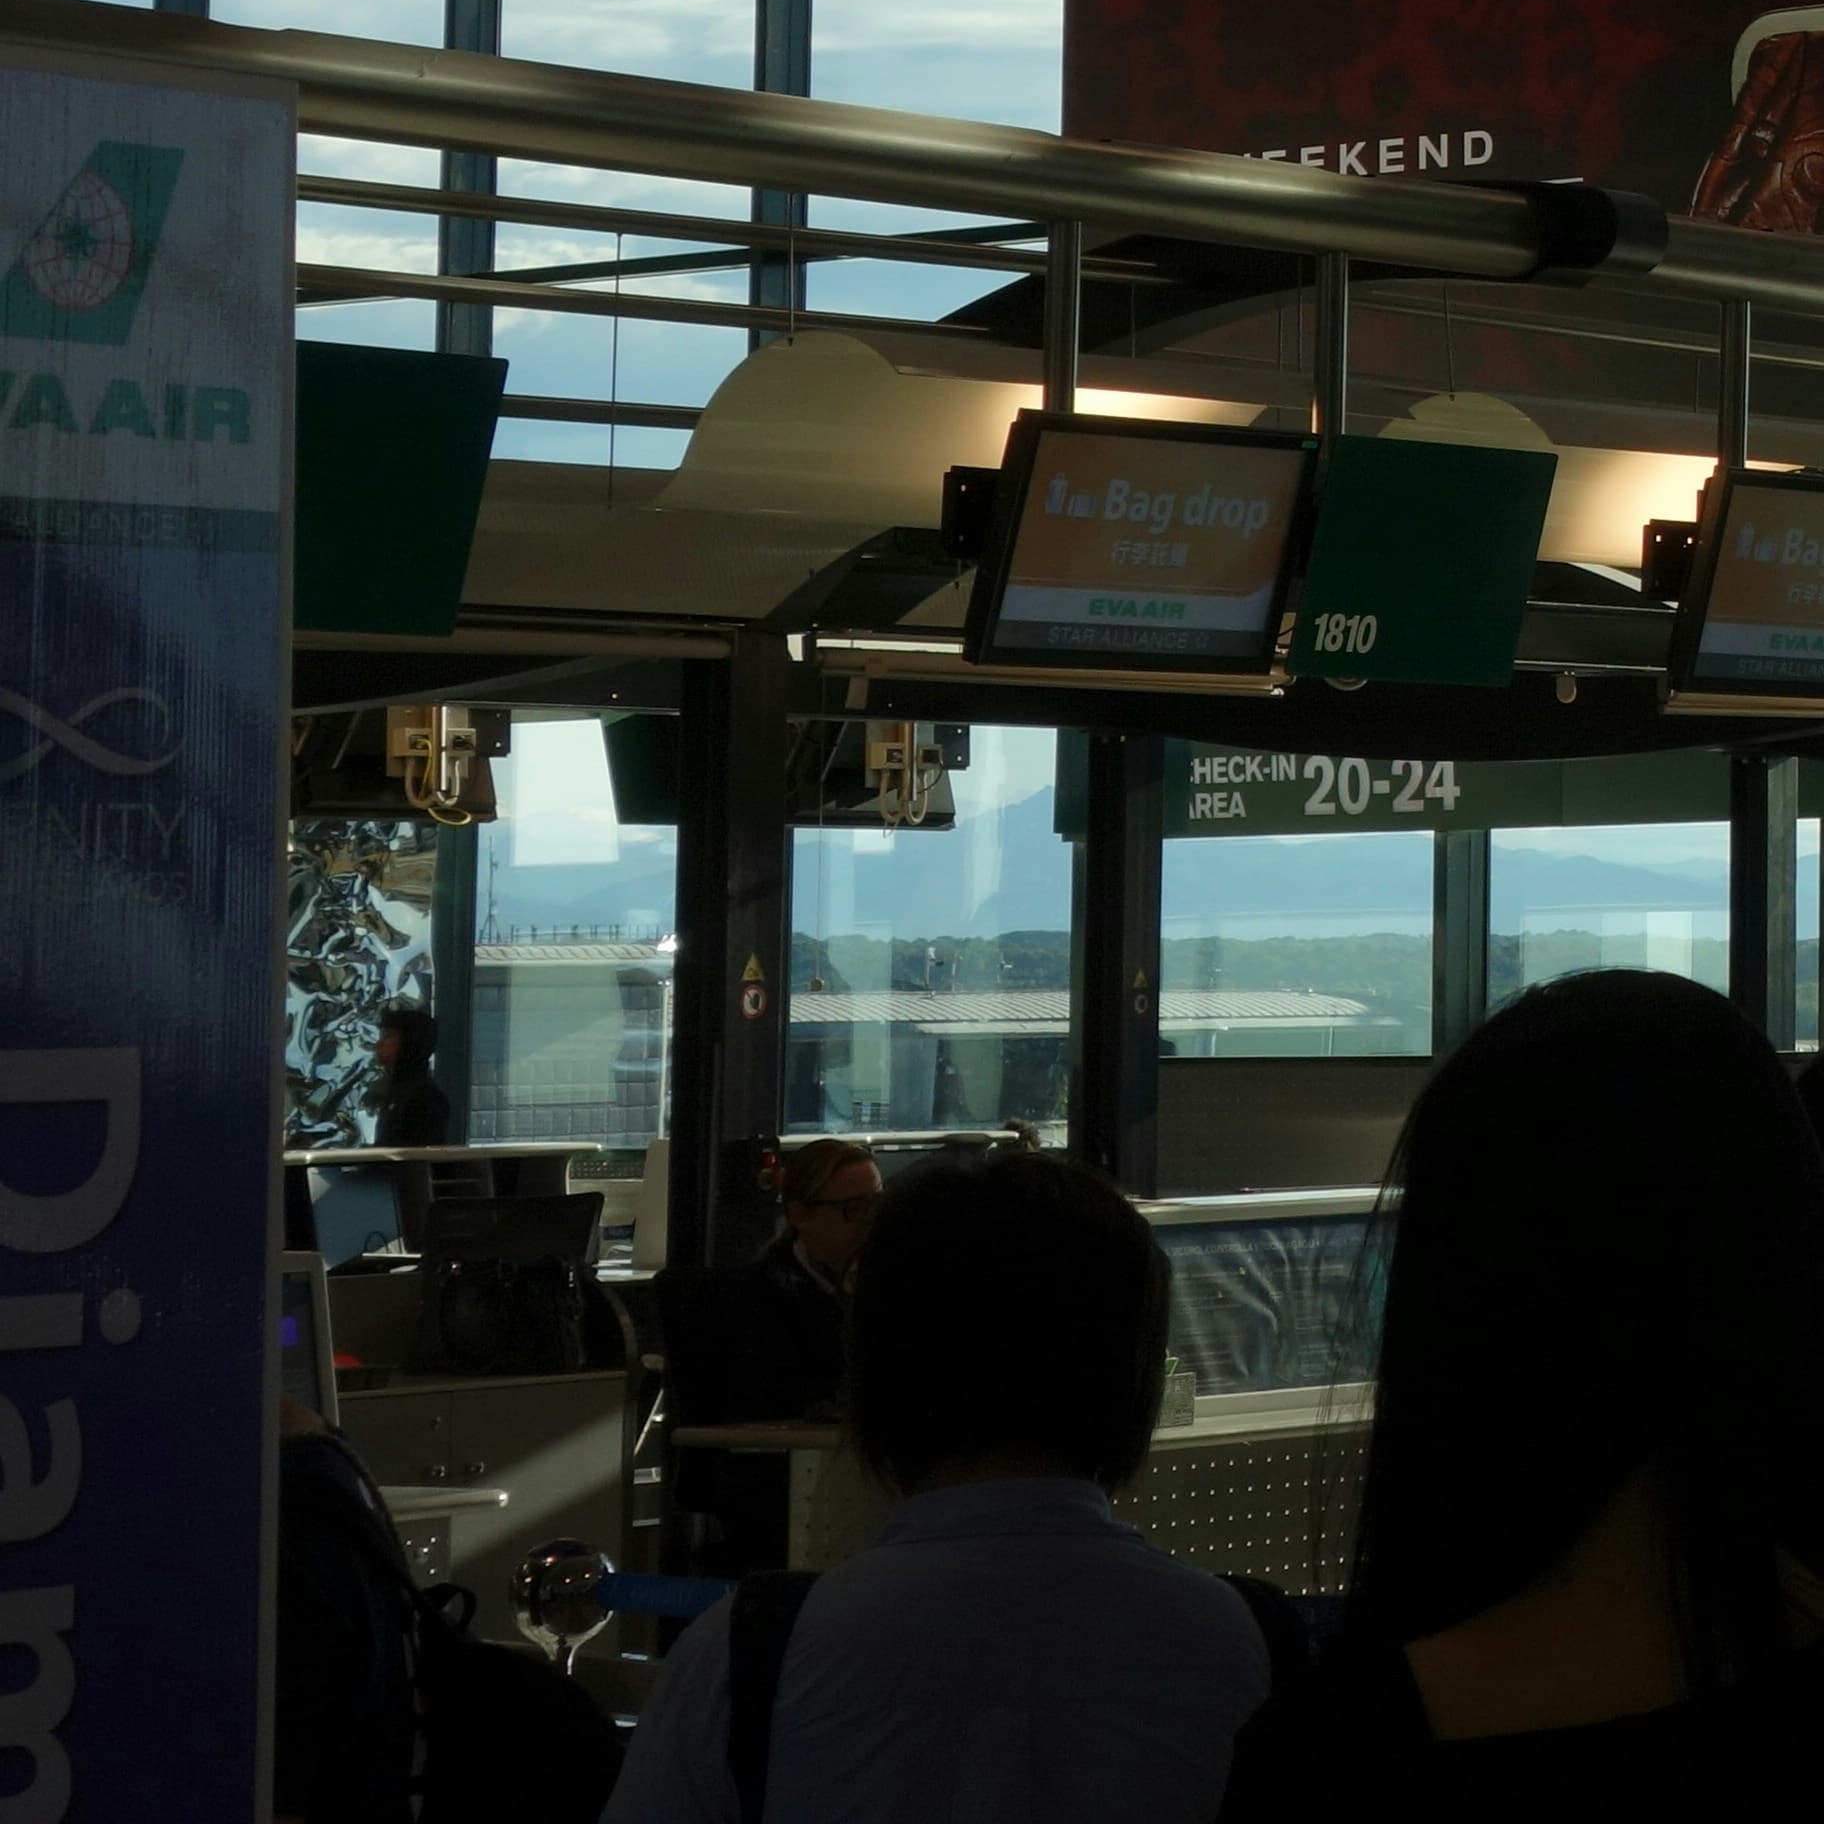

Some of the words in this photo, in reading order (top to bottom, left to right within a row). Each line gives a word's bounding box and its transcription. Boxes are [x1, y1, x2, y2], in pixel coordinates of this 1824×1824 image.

[1243, 130, 1493, 176] EKEND
[1104, 478, 1178, 535] Bag
[1183, 483, 1270, 540] drop
[1048, 625, 1097, 645] STAR
[1314, 613, 1378, 654] 1810
[1190, 754, 1296, 784] HECK-IN
[1303, 755, 1461, 816] 20-24
